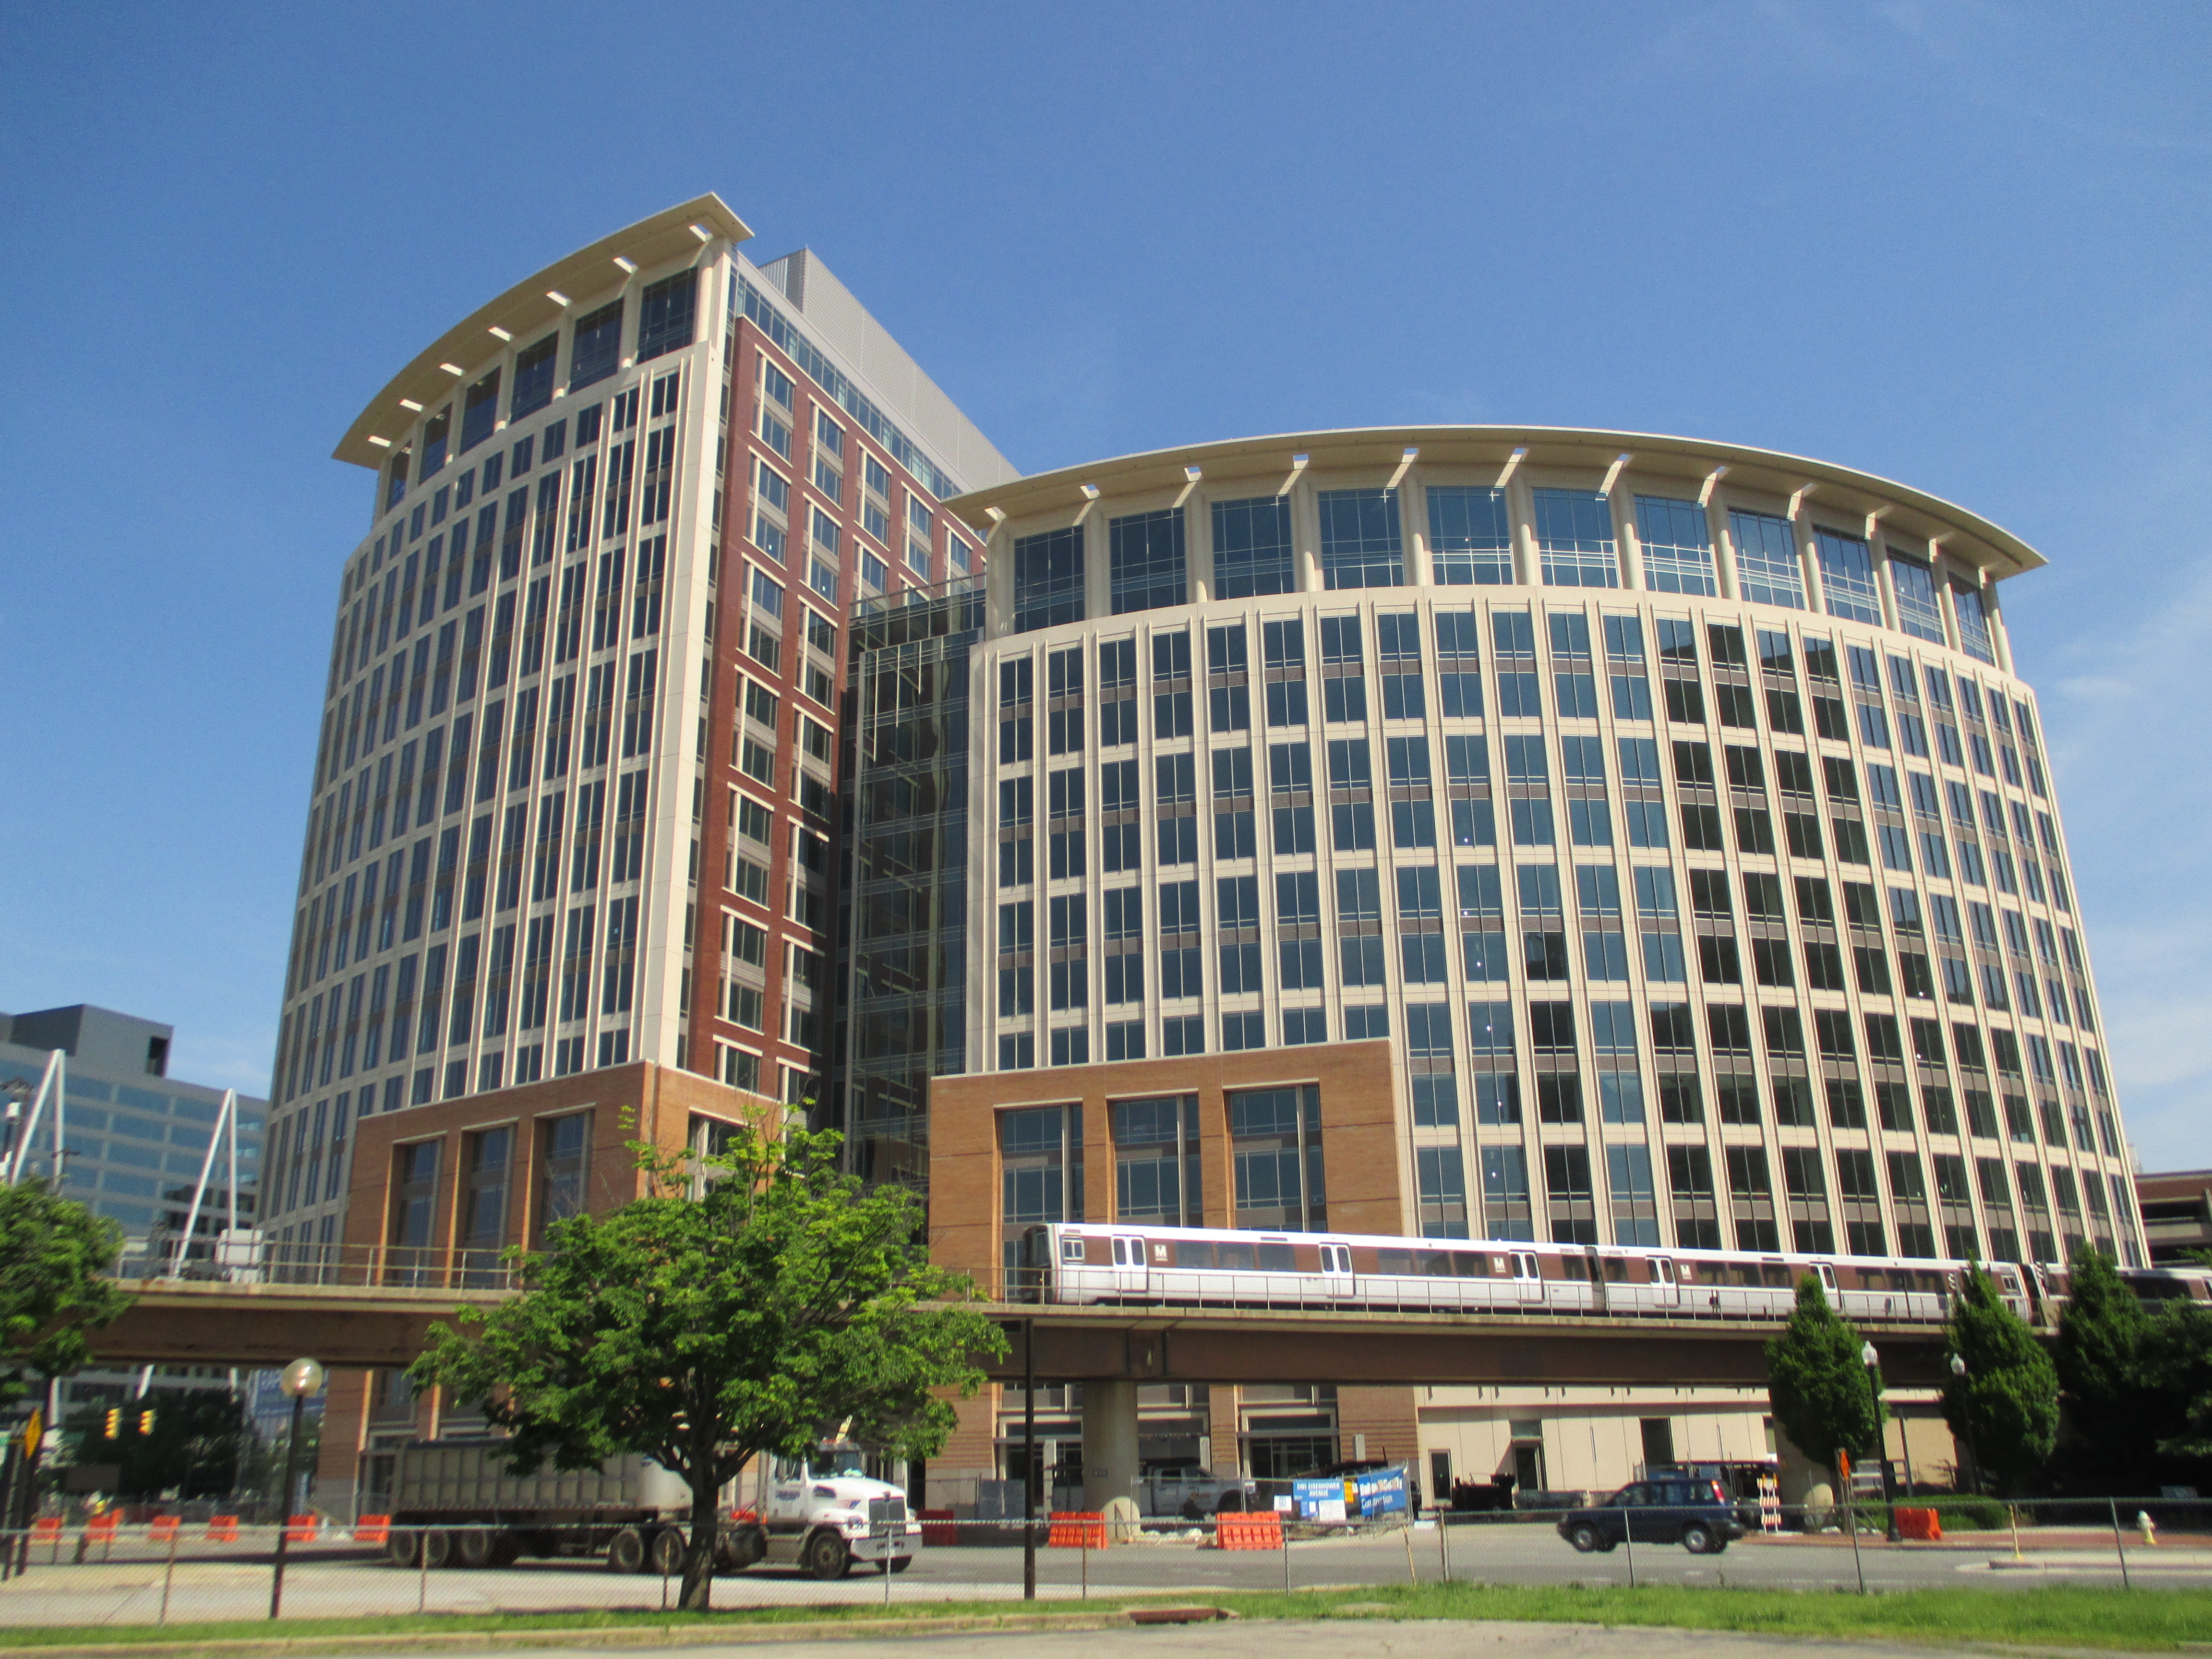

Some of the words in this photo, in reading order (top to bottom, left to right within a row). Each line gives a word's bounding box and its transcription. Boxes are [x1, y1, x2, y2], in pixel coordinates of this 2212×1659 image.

[1154, 1245, 1167, 1257] M
[1493, 1257, 1505, 1269] M
[1680, 1264, 1692, 1276] M
[1359, 1482, 1380, 1496] Balfou
[1382, 1477, 1402, 1491] Beaty
